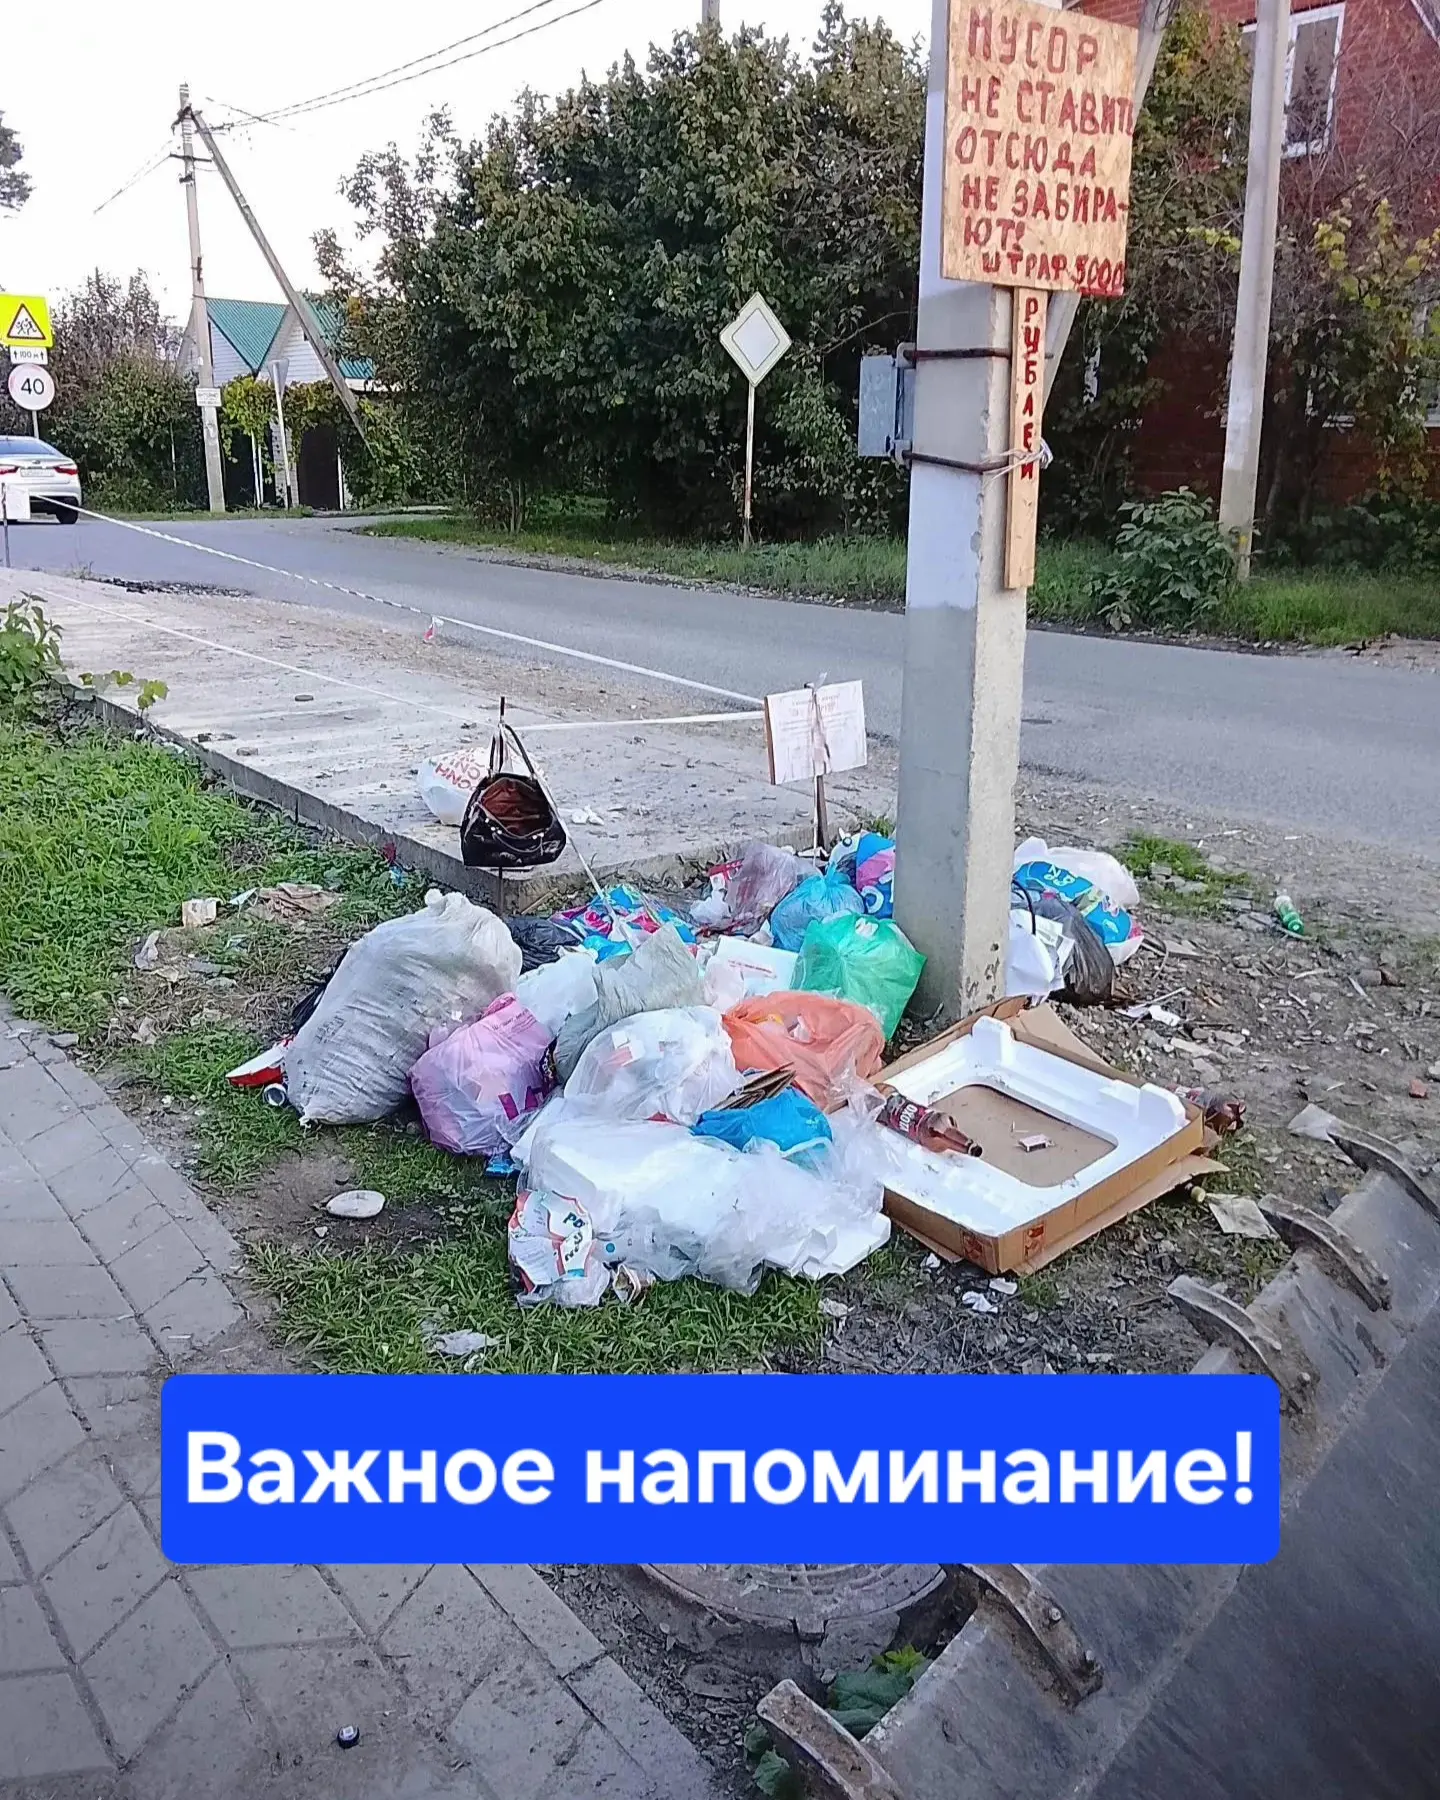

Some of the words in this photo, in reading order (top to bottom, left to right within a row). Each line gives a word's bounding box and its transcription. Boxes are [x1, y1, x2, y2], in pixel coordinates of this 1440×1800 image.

[968, 7, 1099, 75] МУСОР
[961, 75, 1000, 119] НЕ
[955, 126, 1097, 179] ОТСЮДА
[962, 174, 1000, 212] НЕ
[963, 215, 1026, 252] ЮТ!
[982, 251, 1067, 281] ШТРАФ
[1071, 253, 1125, 290] 5000
[21, 378, 45, 395] 40
